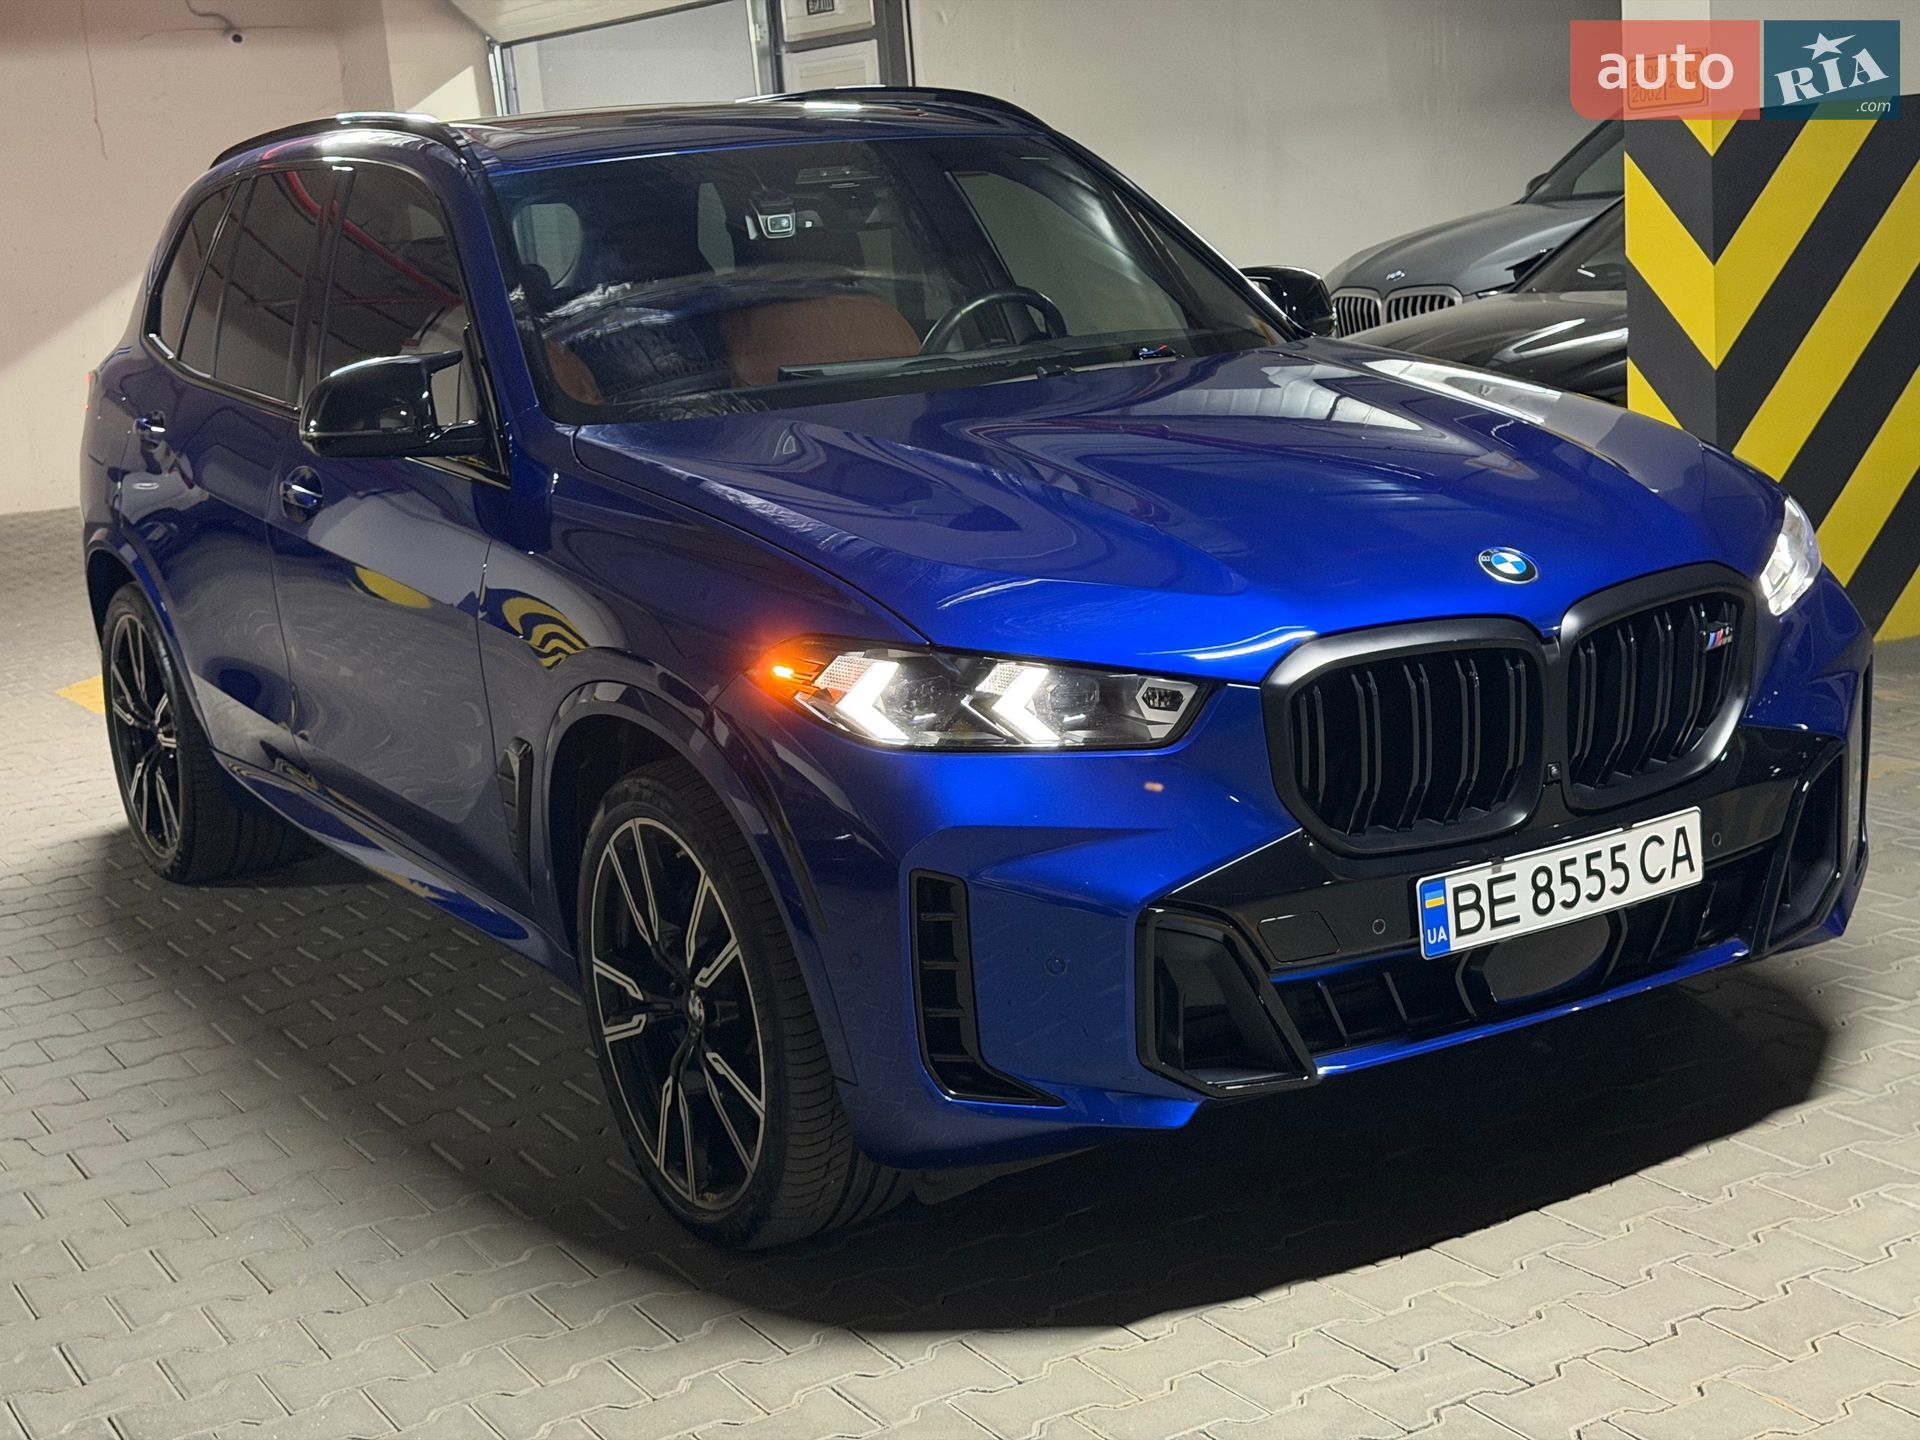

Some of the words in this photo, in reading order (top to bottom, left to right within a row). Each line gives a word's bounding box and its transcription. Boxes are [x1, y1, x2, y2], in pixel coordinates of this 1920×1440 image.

[1452, 872, 1521, 938] BE
[1531, 843, 1630, 916] 8555
[1640, 826, 1695, 884] CA
[1427, 926, 1448, 944] UA
